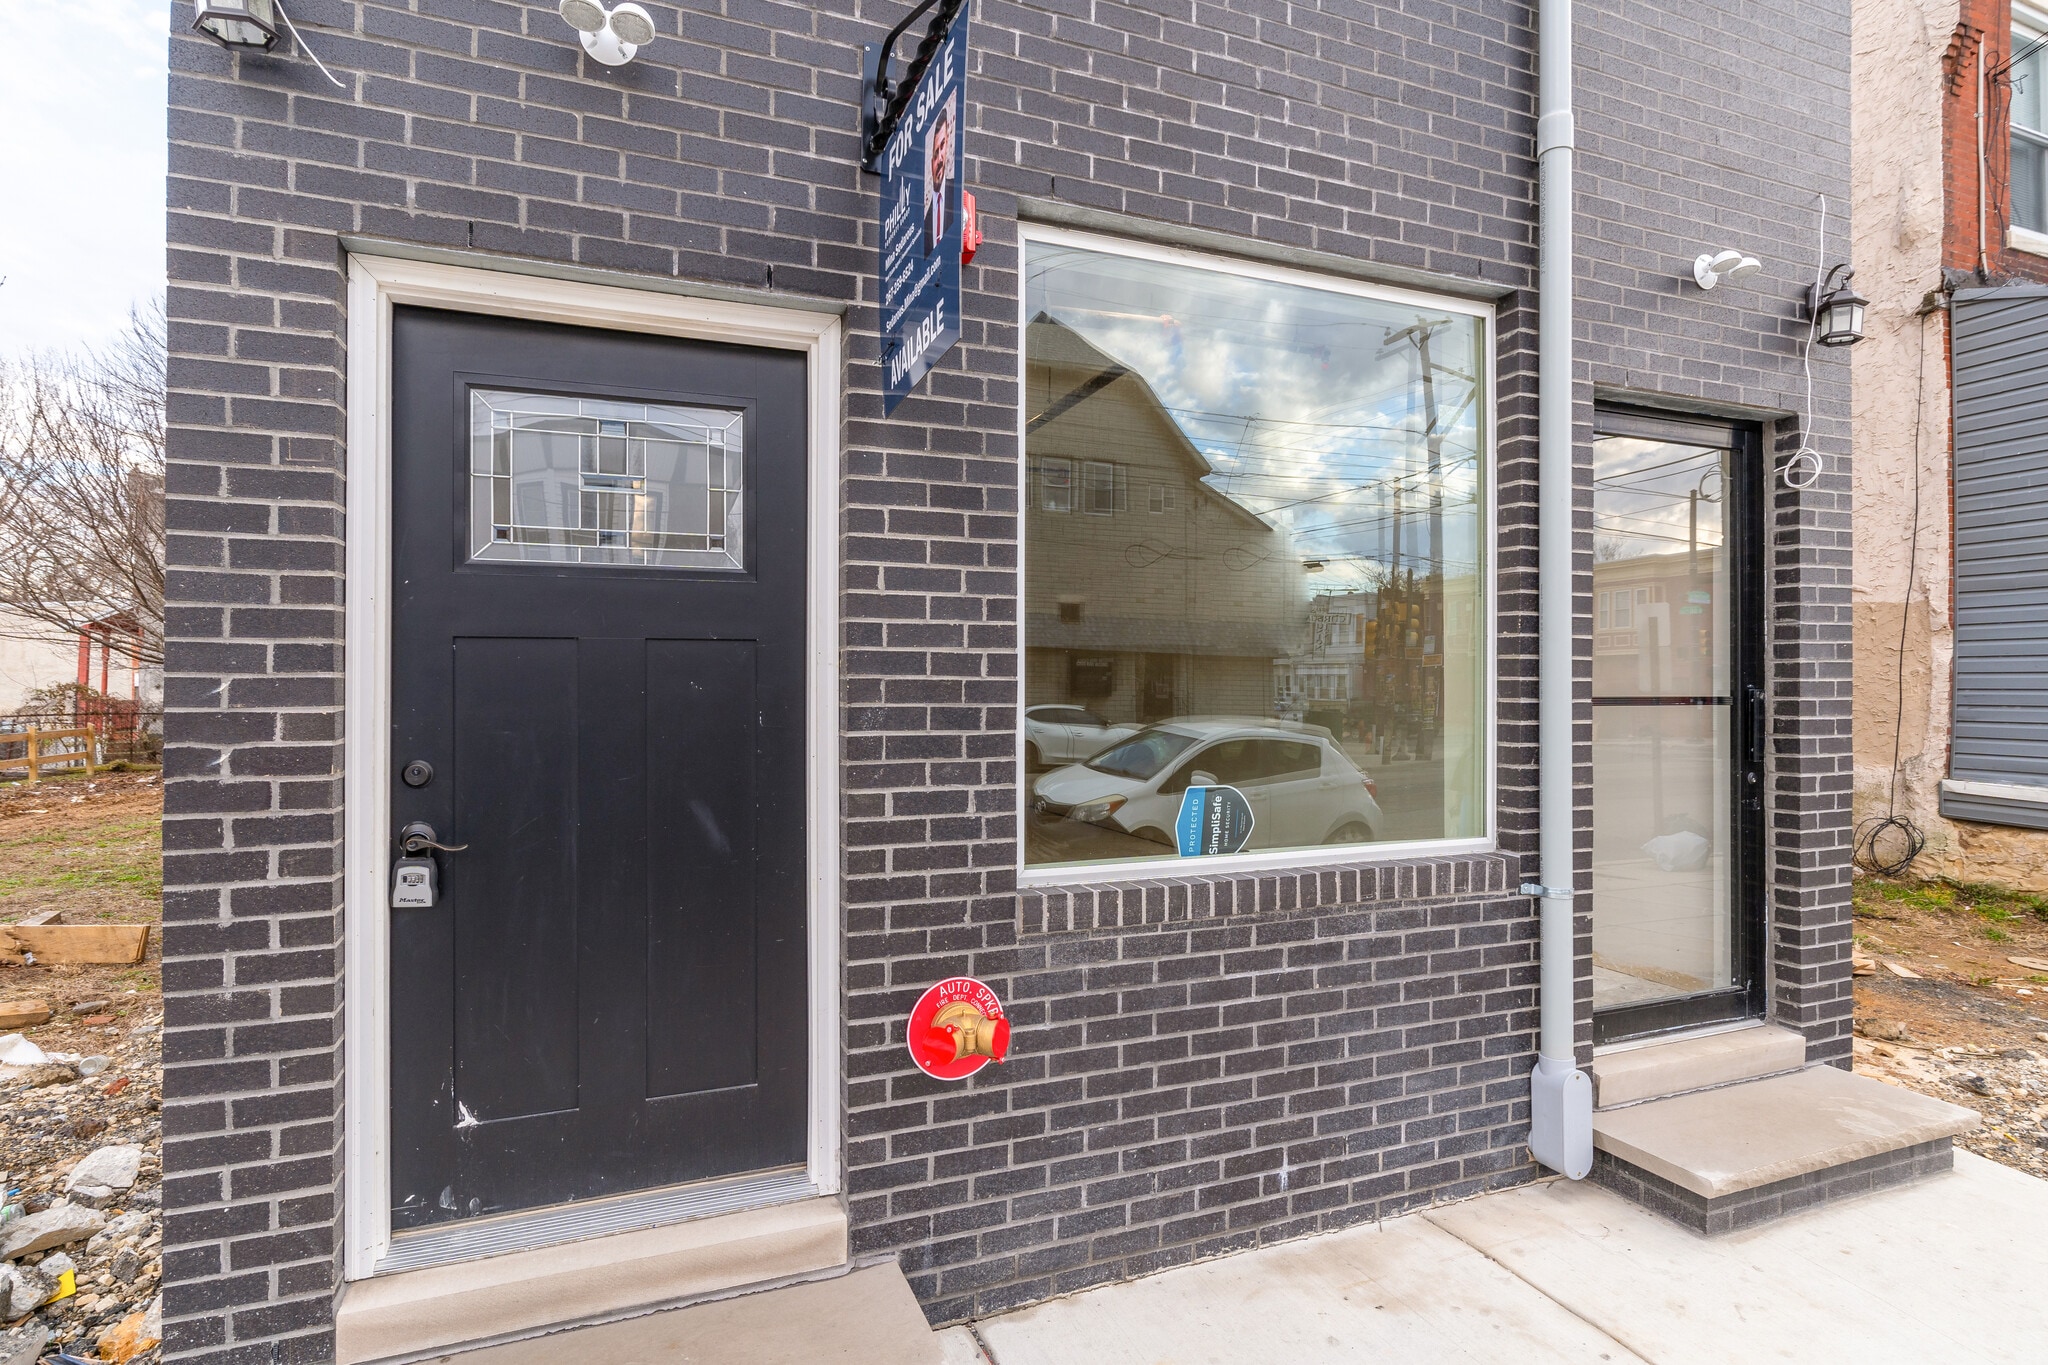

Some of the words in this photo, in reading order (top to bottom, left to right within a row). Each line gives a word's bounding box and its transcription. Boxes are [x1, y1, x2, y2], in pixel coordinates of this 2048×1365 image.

[888, 113, 914, 183] FOR
[915, 37, 955, 133] SALE
[885, 177, 911, 240] PHILLY
[891, 297, 945, 390] AVAILABLE
[1188, 798, 1199, 853] PROTECTED
[1208, 795, 1223, 855] SimpliSafe
[936, 998, 949, 1008] FIRE
